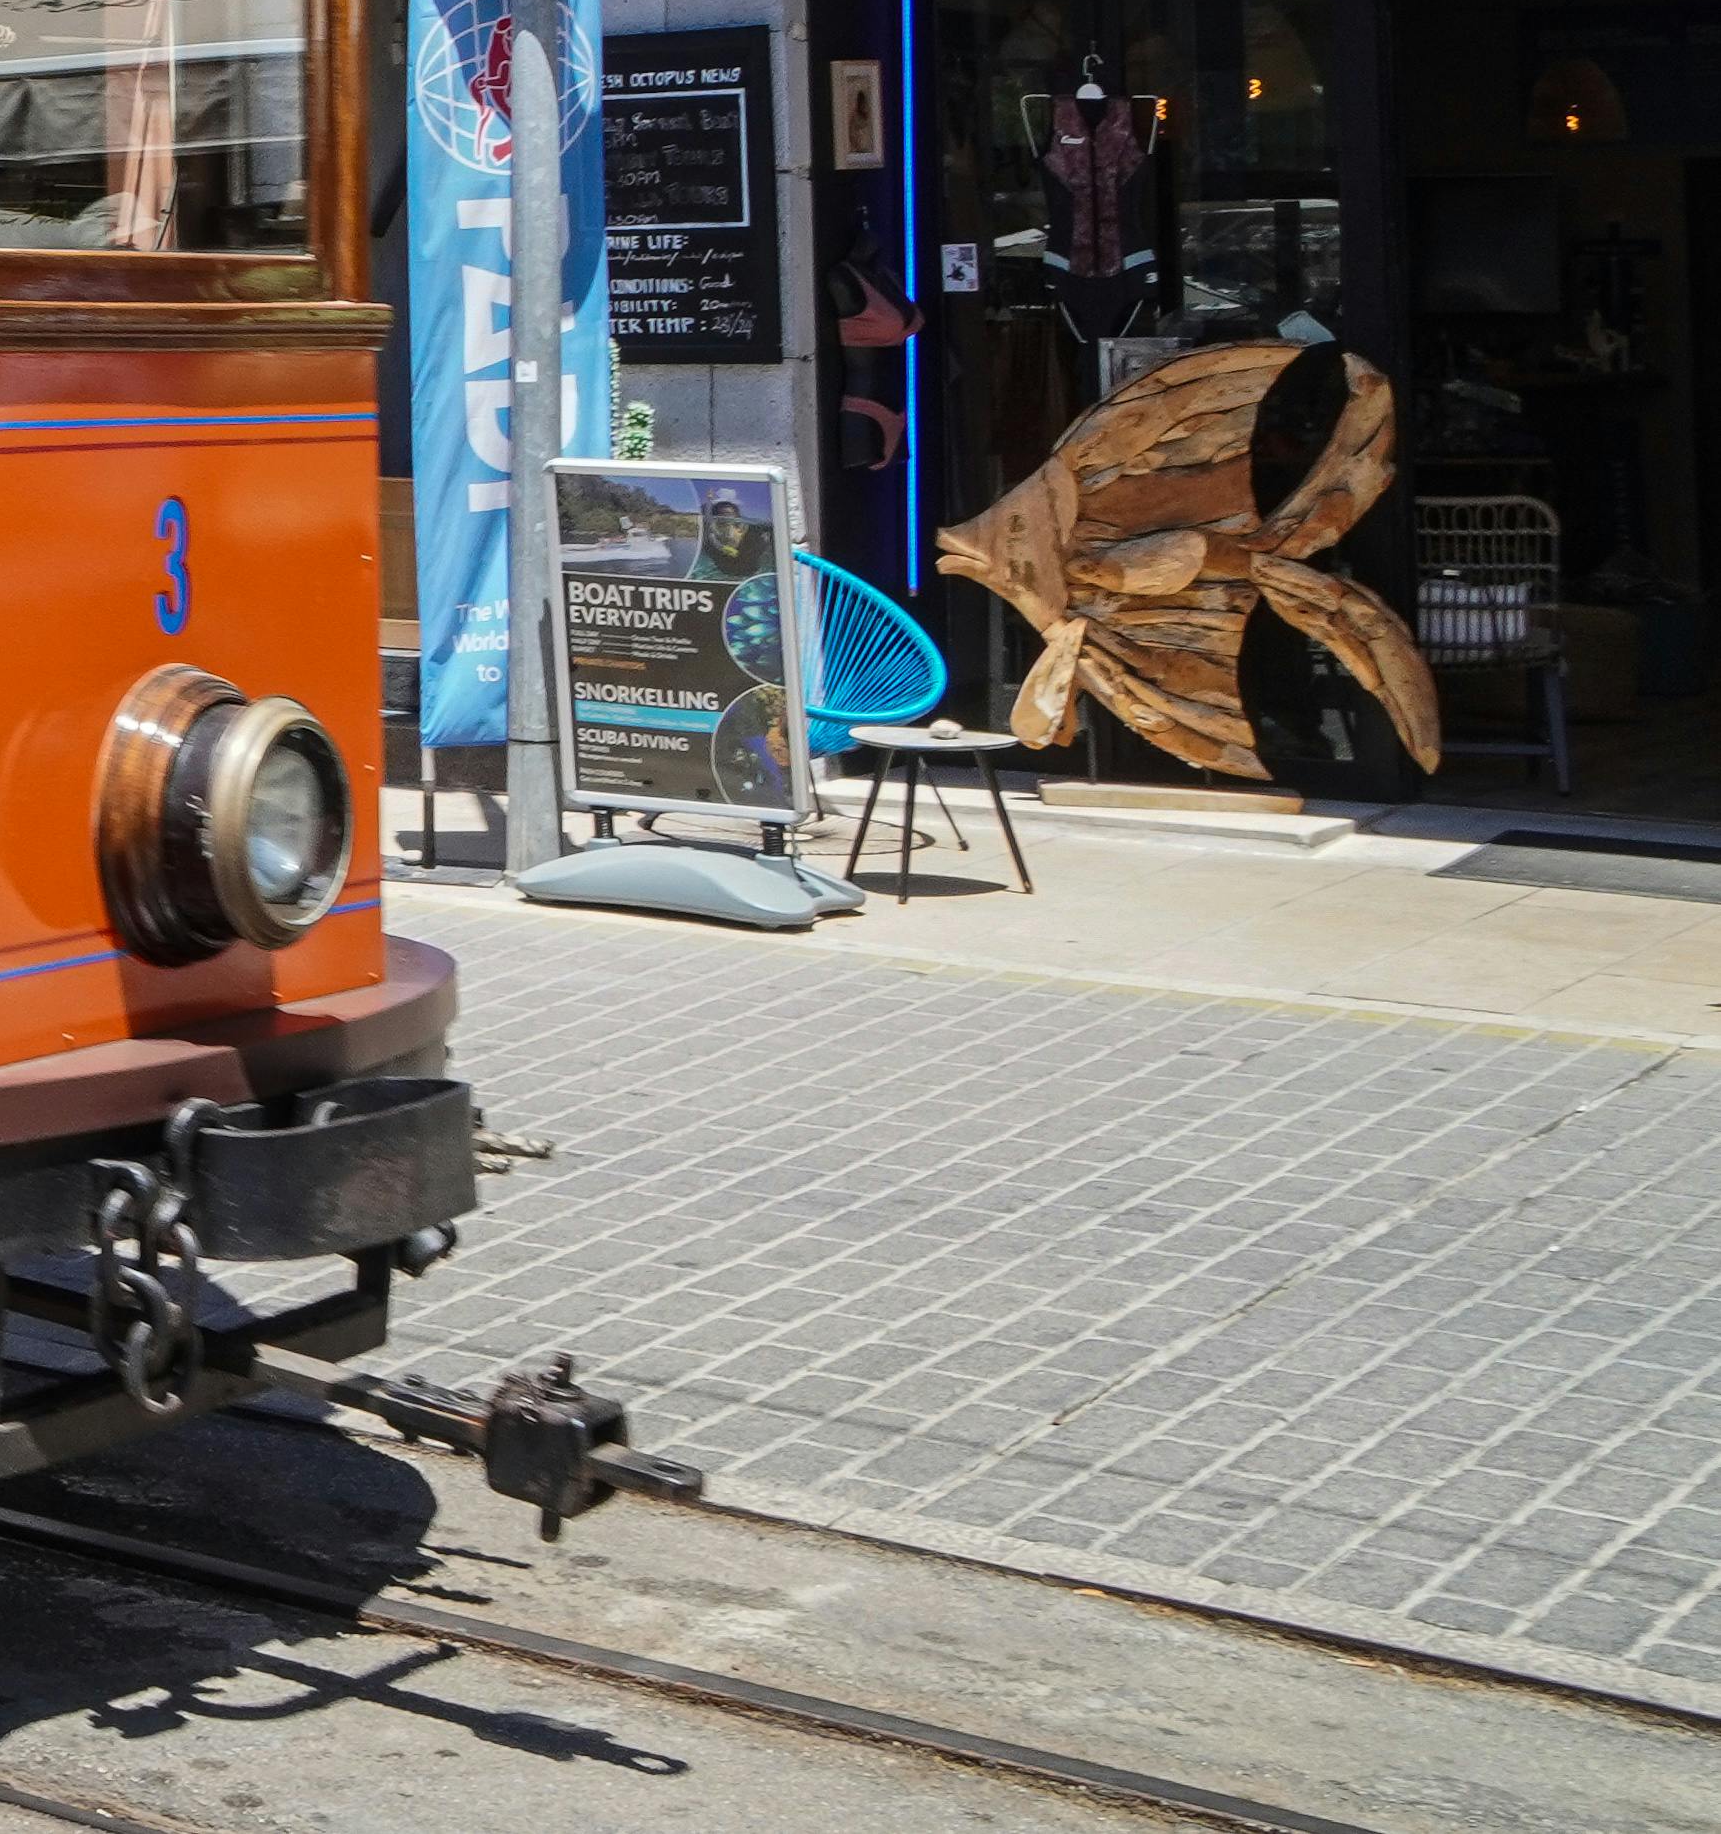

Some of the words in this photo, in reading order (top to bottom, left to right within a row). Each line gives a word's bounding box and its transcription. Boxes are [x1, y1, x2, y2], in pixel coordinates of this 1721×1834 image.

[602, 74, 624, 89] ESH
[629, 69, 696, 87] OCTOPUS
[700, 67, 742, 83] NEWS
[606, 235, 641, 250] RINE
[647, 234, 690, 250] LIFE:
[607, 299, 678, 314] SIBILITY:
[607, 318, 643, 335] TER
[154, 497, 189, 635] 3
[568, 581, 636, 608] BOAT
[638, 586, 714, 613] TRIPS
[454, 603, 493, 623] The
[569, 605, 677, 631] EVERYDAY
[475, 664, 502, 682] to
[574, 681, 720, 711] SNORKELLING
[576, 727, 630, 747] SCUBA
[630, 732, 690, 752] DIVING
